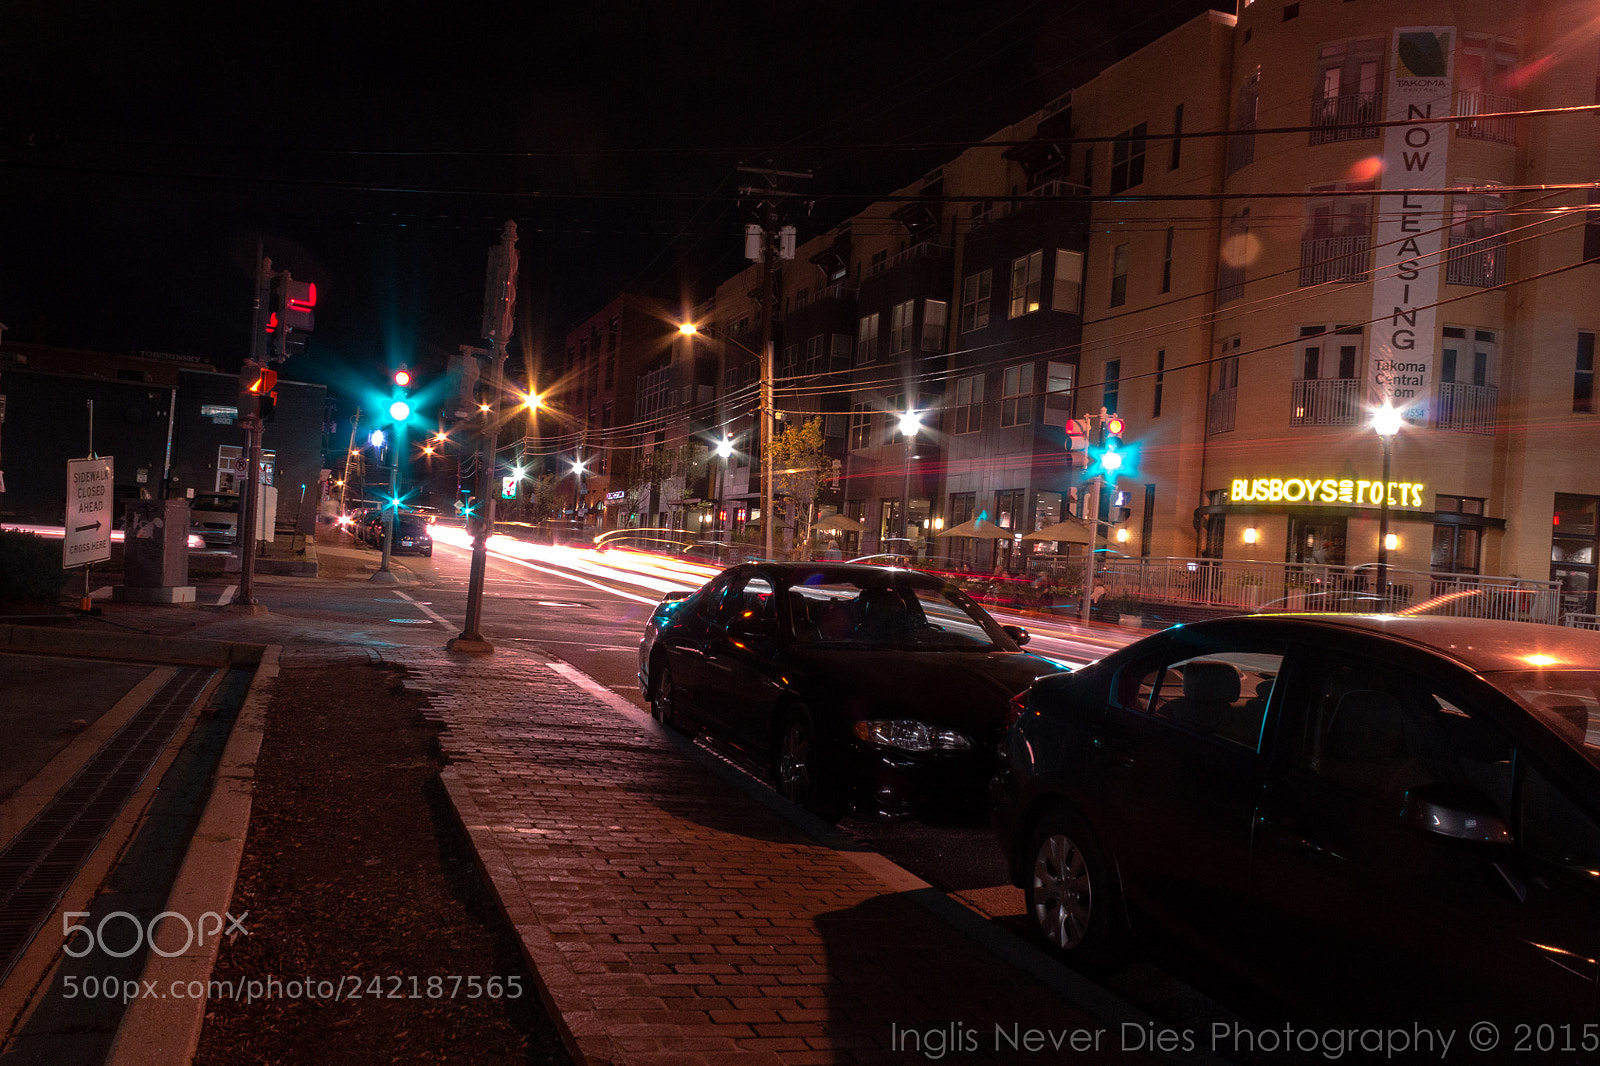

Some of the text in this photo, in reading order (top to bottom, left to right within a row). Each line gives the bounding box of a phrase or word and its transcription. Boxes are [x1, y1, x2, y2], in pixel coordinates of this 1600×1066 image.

[1396, 79, 1446, 87] TAKOMA
[1391, 104, 1431, 350] NOW LEASING
[140, 350, 201, 363] TORCHINSKY
[1375, 359, 1426, 372] Takoma
[73, 469, 109, 483] SIDEWALK
[77, 485, 105, 499] CLOSED
[1231, 478, 1339, 502] BUSBOYS
[1338, 479, 1354, 503] AND
[78, 500, 103, 514] AHEAD
[69, 539, 107, 555] CROSS HERE
